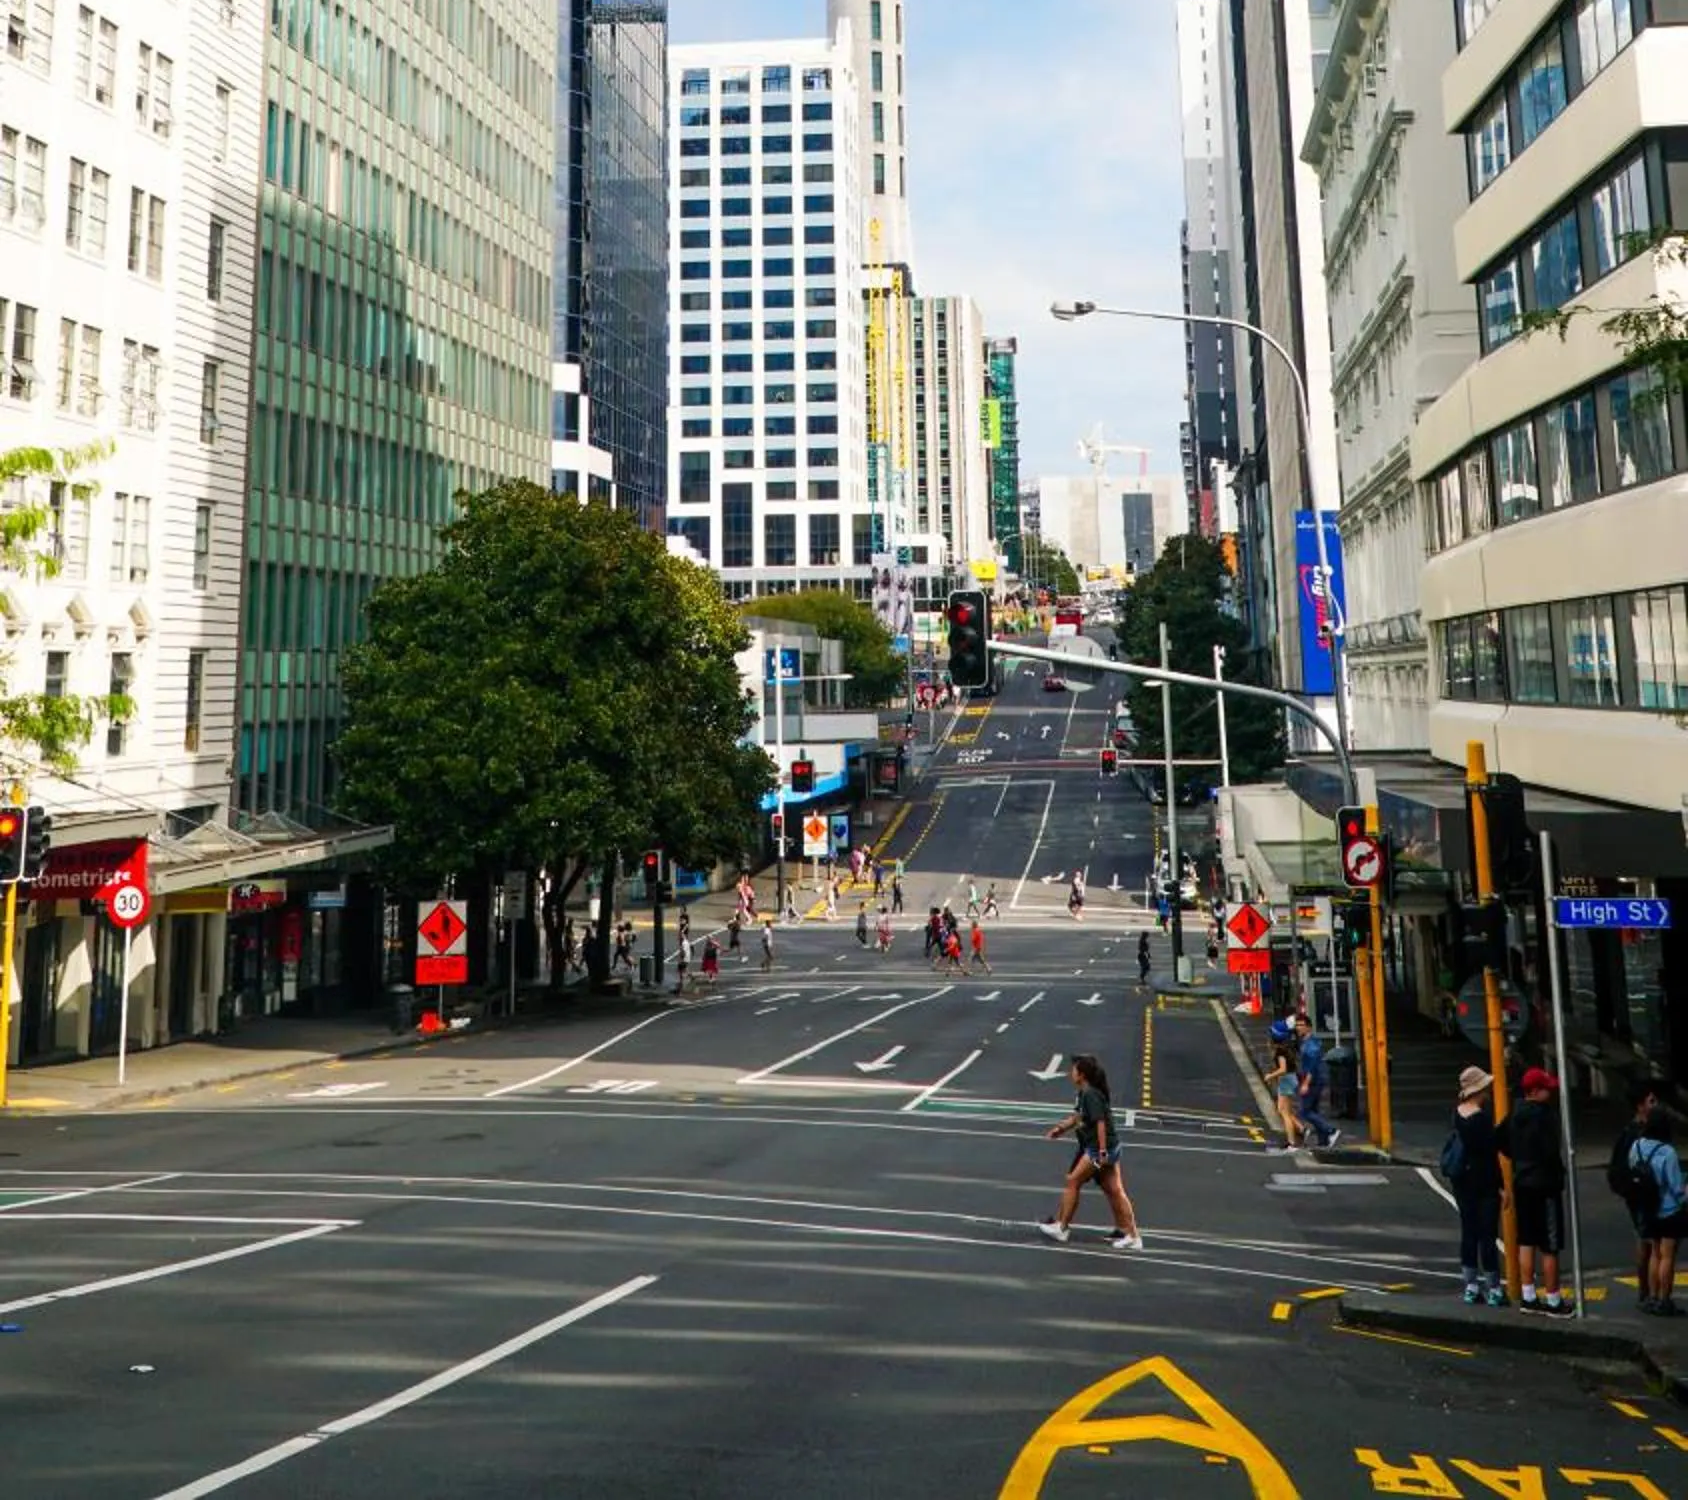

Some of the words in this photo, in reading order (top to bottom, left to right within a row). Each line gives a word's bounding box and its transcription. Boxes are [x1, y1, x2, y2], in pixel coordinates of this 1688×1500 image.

[31, 867, 132, 889] tometrists
[117, 894, 140, 912] 30
[1571, 901, 1617, 924] High
[1628, 901, 1651, 921] St
